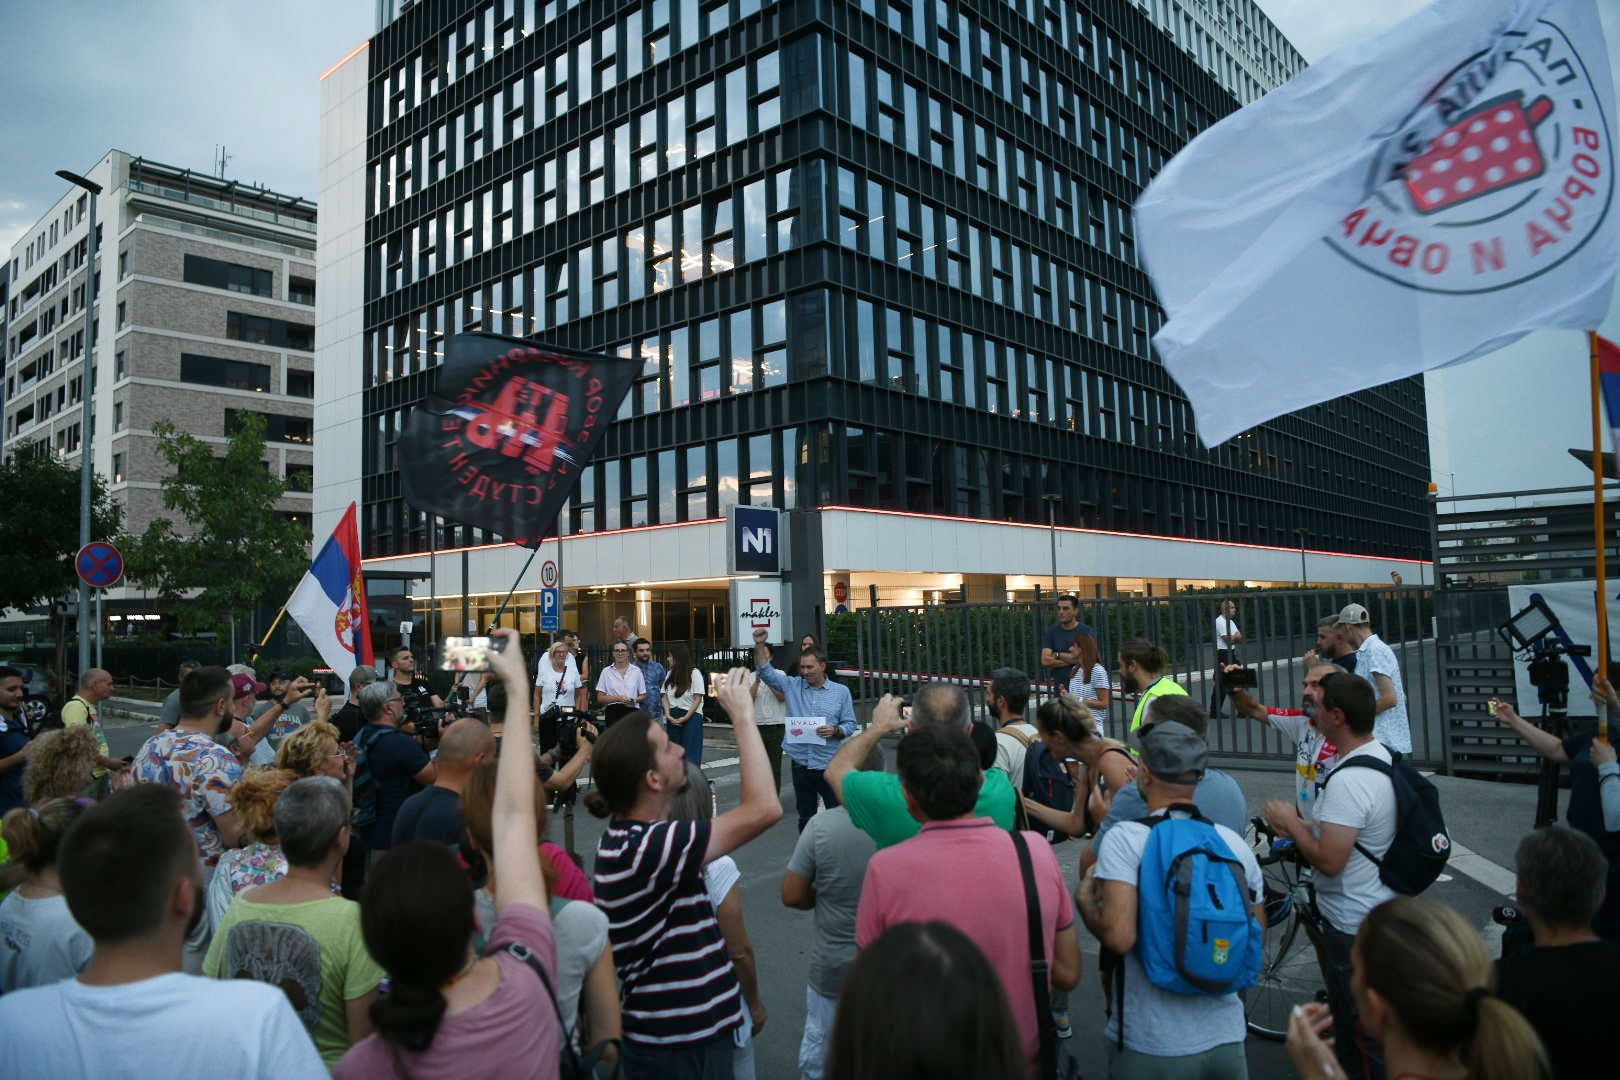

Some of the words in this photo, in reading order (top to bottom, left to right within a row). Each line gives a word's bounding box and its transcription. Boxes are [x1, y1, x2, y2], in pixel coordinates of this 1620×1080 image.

[741, 526, 772, 554] N1
[545, 566, 554, 582] 10
[544, 591, 554, 614] P
[740, 605, 781, 619] makler
